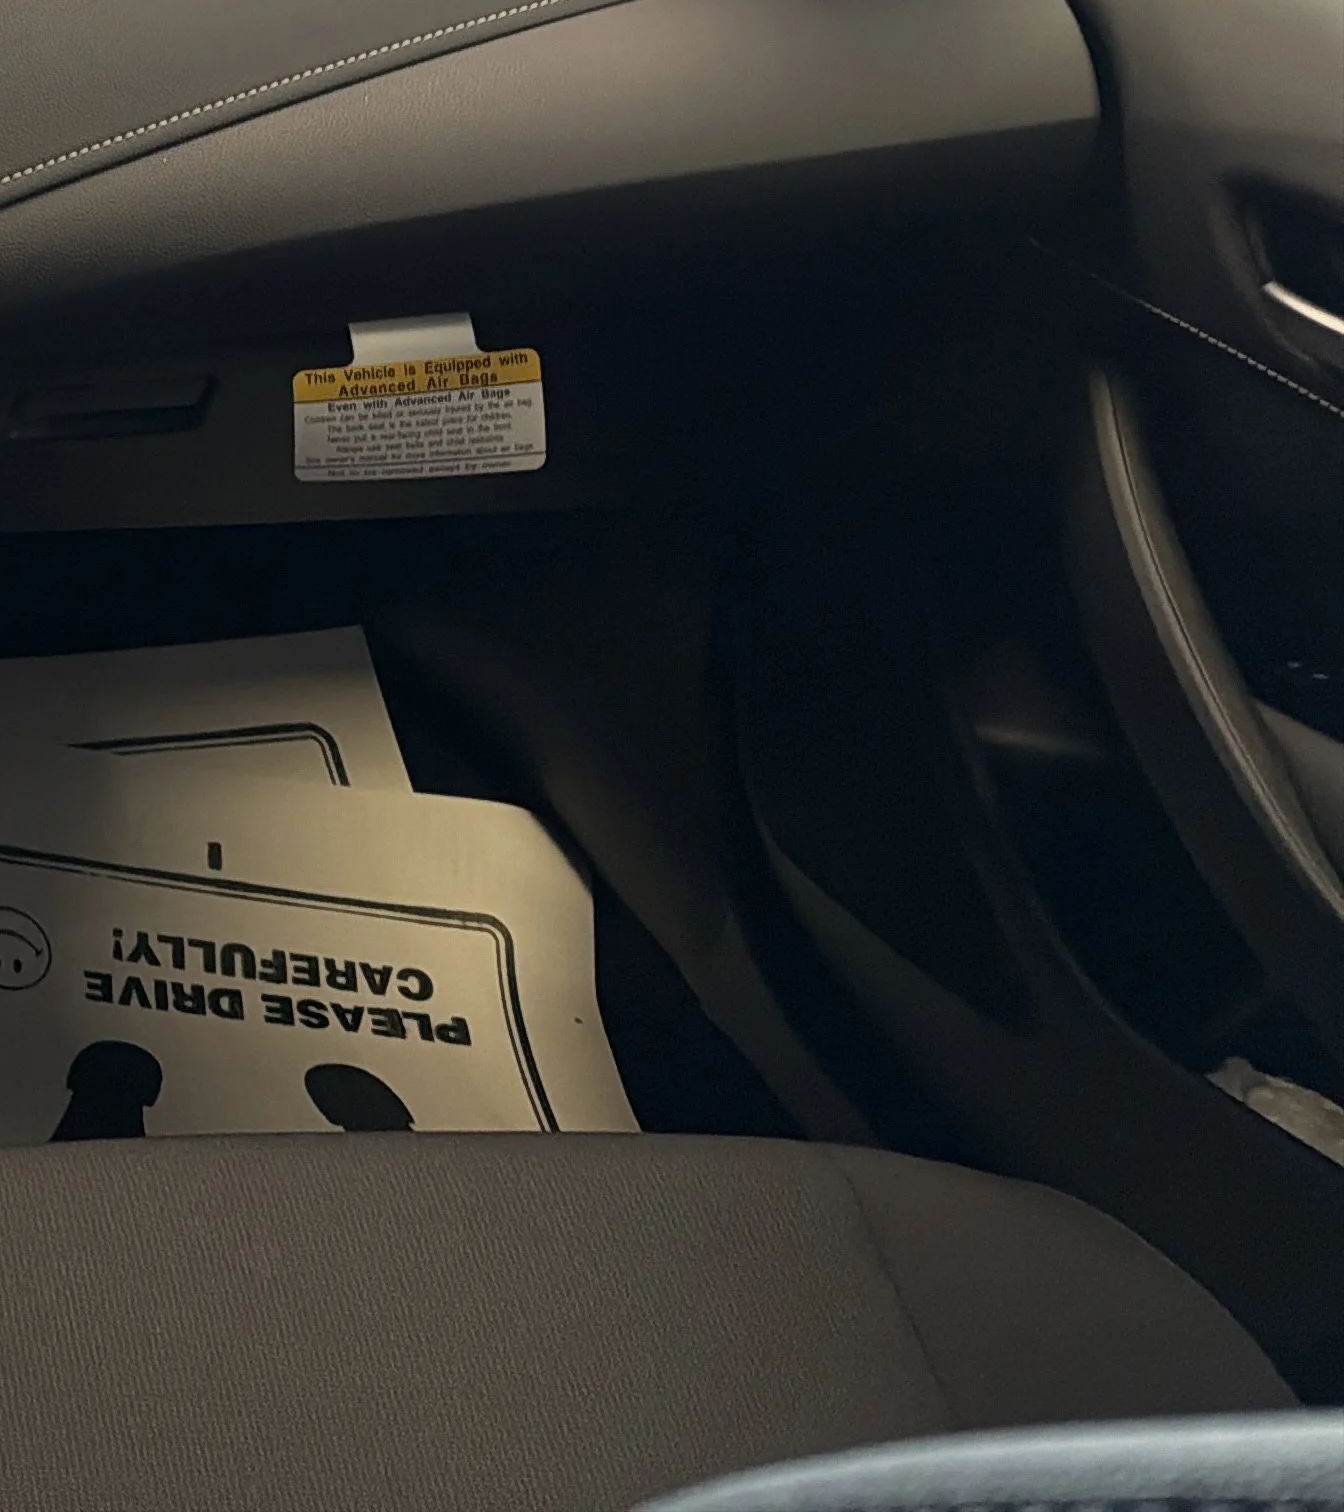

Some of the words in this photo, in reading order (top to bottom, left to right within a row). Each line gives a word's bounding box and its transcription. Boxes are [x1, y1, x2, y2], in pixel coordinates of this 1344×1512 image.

[305, 371, 337, 386] This
[343, 366, 396, 383] Vehicle
[403, 363, 417, 377] is
[424, 355, 492, 375] Equipped
[498, 351, 529, 367] with
[338, 379, 417, 398] Advanced
[426, 375, 449, 389] Air
[459, 372, 499, 387] Bags
[327, 401, 357, 413] Even
[363, 398, 389, 410] with
[394, 392, 453, 408] Advanced
[458, 391, 475, 402] Air
[481, 388, 512, 402] Bags
[112, 930, 435, 1002] CAREFULLY!
[83, 969, 245, 1021] DRIVE
[260, 992, 473, 1047] PLEASE
